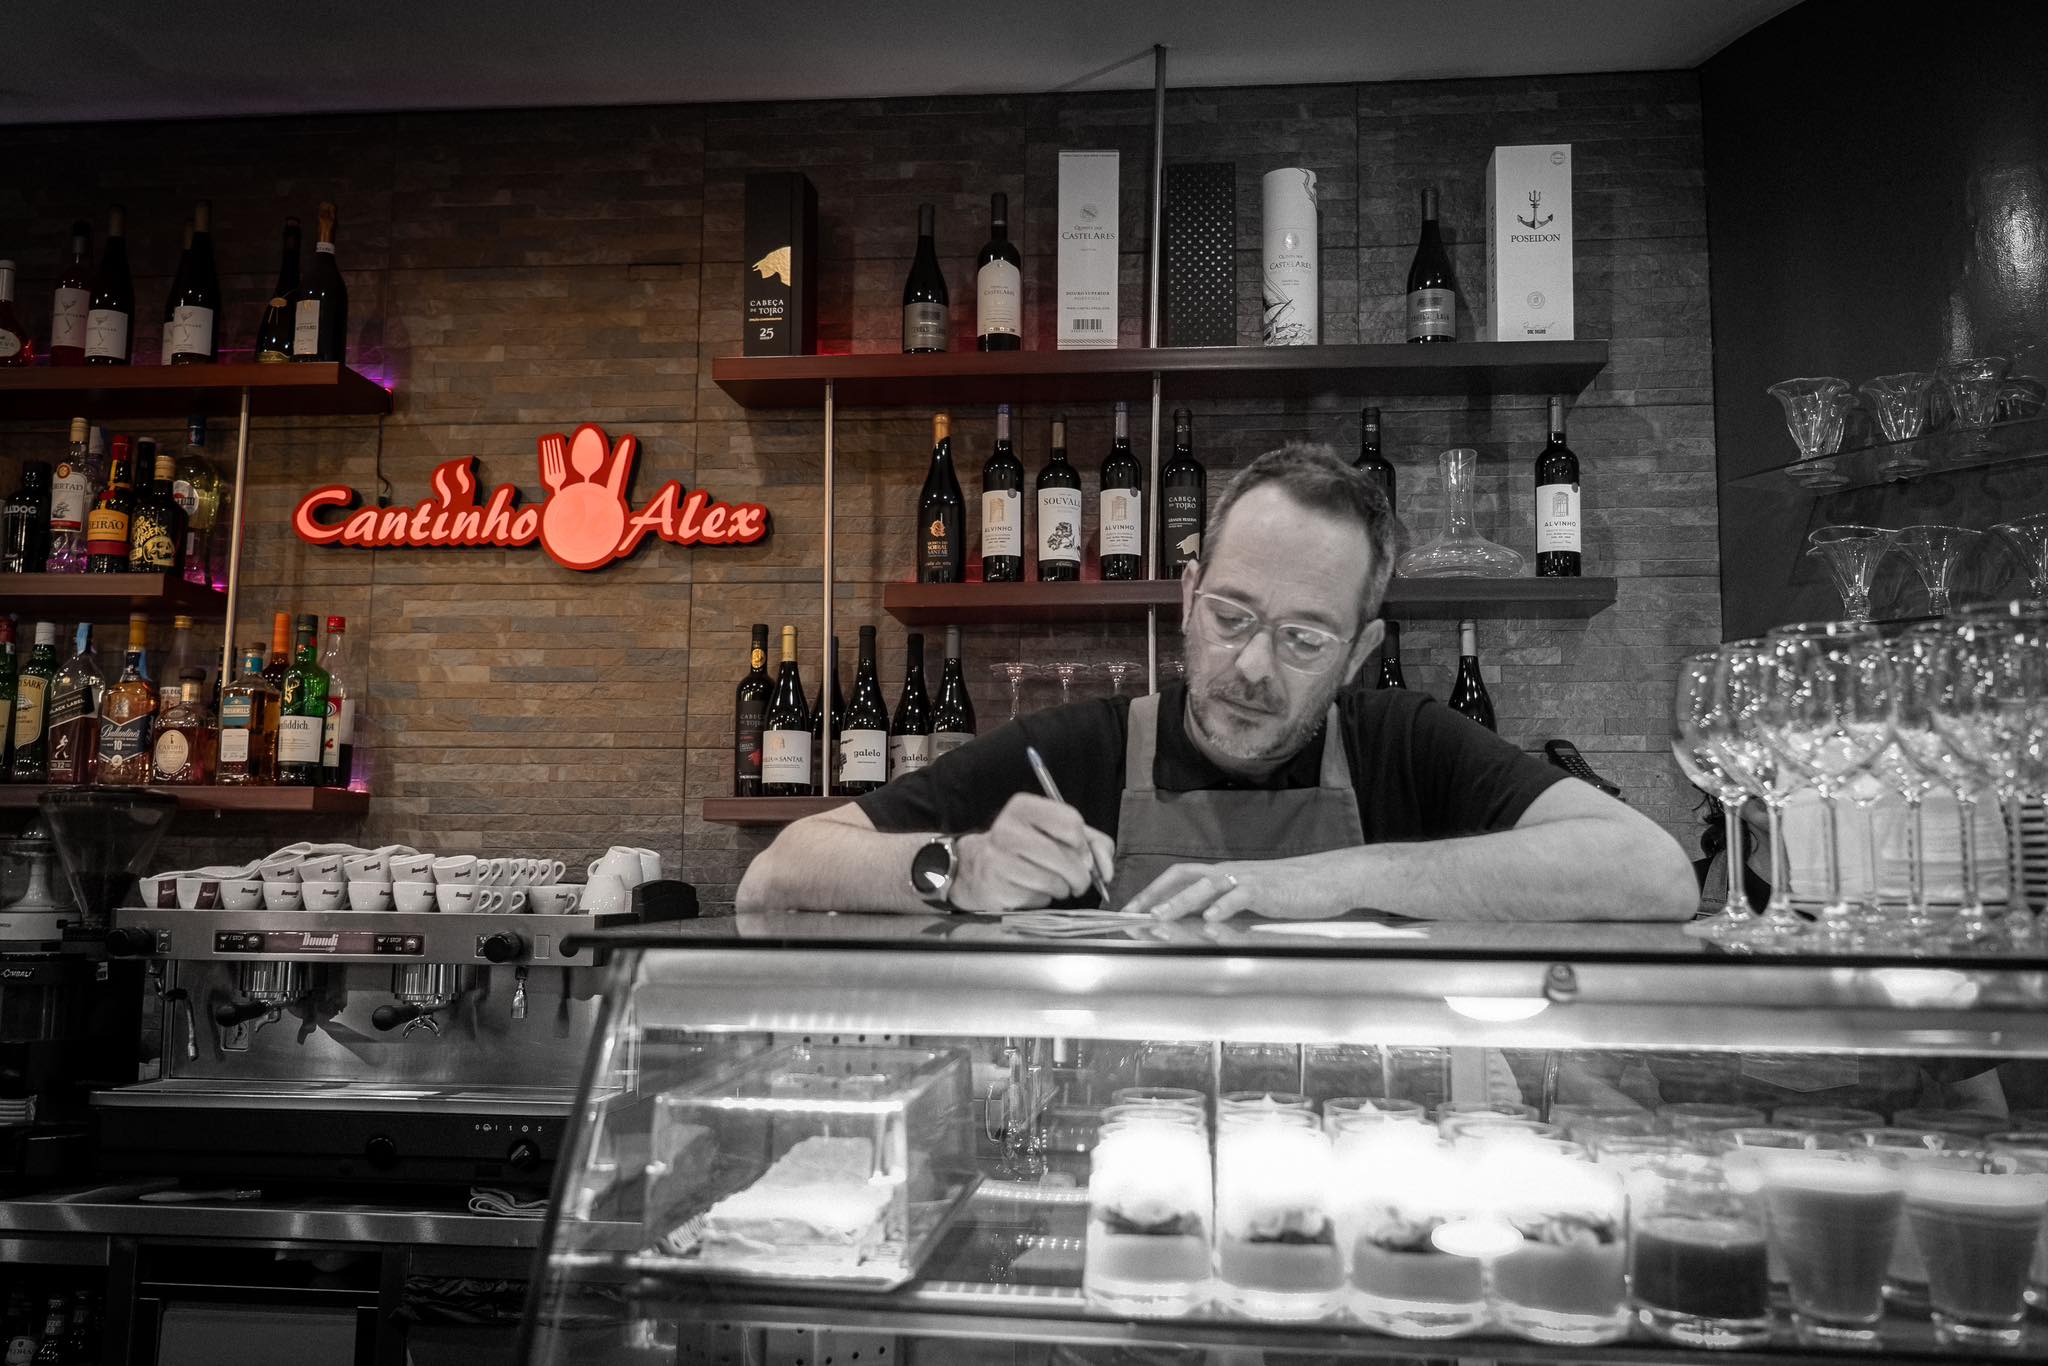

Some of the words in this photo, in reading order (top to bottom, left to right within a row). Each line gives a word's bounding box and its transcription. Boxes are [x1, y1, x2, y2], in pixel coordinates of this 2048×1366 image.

[1511, 233, 1560, 243] POSEIDON
[750, 299, 784, 307] CABEÇA
[760, 327, 774, 341] 25
[295, 486, 539, 542] Cantinho
[618, 483, 762, 552] Alex
[113, 739, 123, 751] 10
[853, 748, 881, 759] galelo
[302, 931, 339, 947] Buondi
